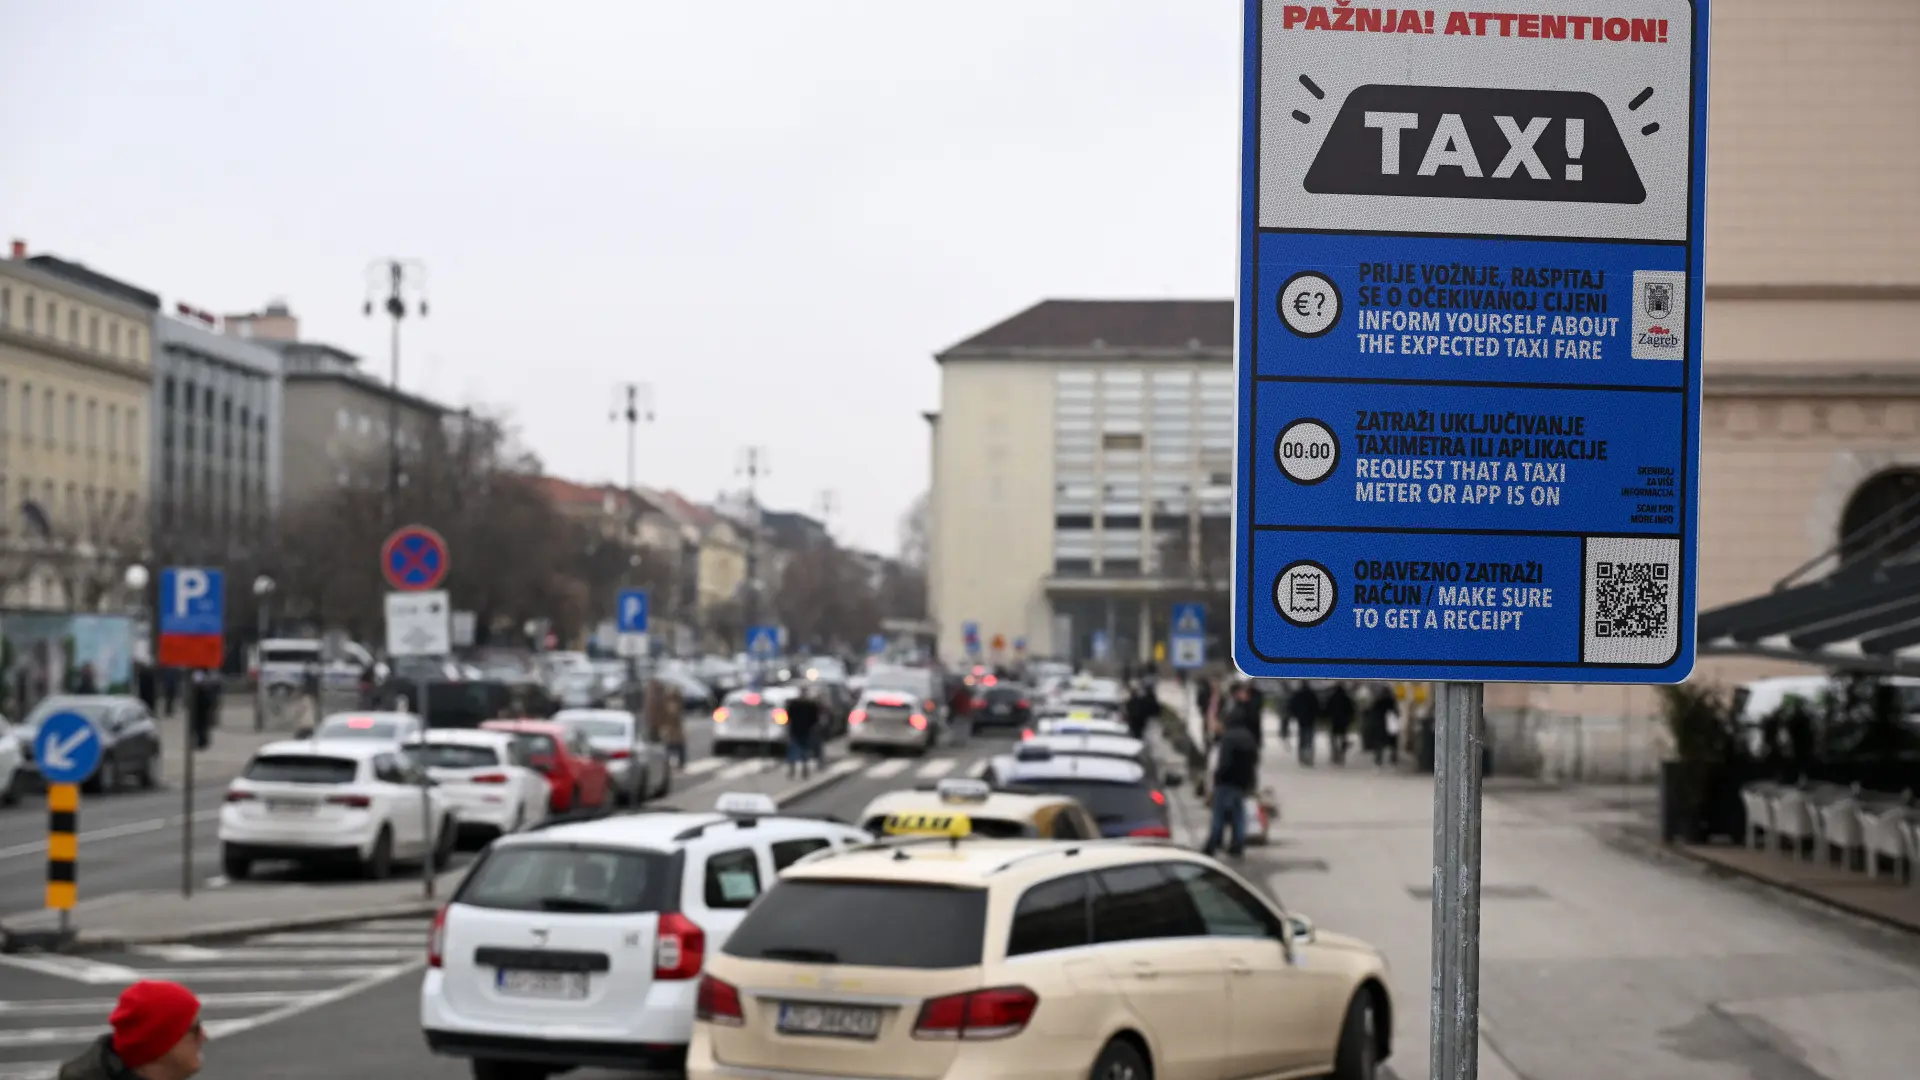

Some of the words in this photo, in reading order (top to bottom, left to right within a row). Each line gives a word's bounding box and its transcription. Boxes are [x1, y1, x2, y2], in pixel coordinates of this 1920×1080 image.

[1283, 0, 1434, 34] PAŽNJA!
[1444, 11, 1668, 43] ATTENTION!
[1364, 111, 1585, 181] TAX!
[1360, 262, 1416, 284] PRIJE
[1421, 263, 1504, 288] VOŽNJE,
[1512, 267, 1605, 290] RASPITAJ
[1293, 291, 1326, 317] €?
[1358, 286, 1381, 307] SE
[1388, 287, 1402, 307] O
[1408, 286, 1537, 311] OČEKIVANOJ
[1543, 292, 1607, 313] CIJENI
[1358, 310, 1440, 332] INFORM
[1446, 312, 1547, 335] YOURSELF
[1550, 316, 1620, 337] ABOUT
[1358, 333, 1395, 354] THE
[1401, 335, 1500, 357] EXPECTED
[1505, 337, 1549, 359] TAXI
[1555, 339, 1602, 360] FARE
[1638, 333, 1678, 348] Zagreb
[1356, 409, 1435, 432] ZATRAŽI
[1441, 411, 1585, 436] UKLJUČIVANJE
[1283, 442, 1330, 459] 00:00
[1355, 435, 1466, 457] TAXIMETRA
[1471, 437, 1494, 457] ILI
[1497, 438, 1608, 460] APLIKACIJE
[1356, 458, 1446, 480] REQUEST
[1450, 461, 1501, 481] THAT
[1504, 462, 1519, 481] A
[1521, 462, 1566, 483] TAXI
[1355, 482, 1422, 503] METER
[1427, 484, 1456, 504] OR
[1461, 485, 1501, 505] APP
[1507, 486, 1526, 505] IS
[1530, 486, 1561, 506] ON
[1630, 515, 1654, 524] MORE
[1636, 504, 1657, 513] SCAN
[1658, 505, 1674, 514] FOR
[1353, 560, 1461, 583] OBAVEZNO
[1465, 561, 1543, 584] ZATRAŽI
[174, 567, 210, 619] P
[1353, 582, 1422, 605] RAČUN
[1426, 585, 1435, 605] /
[1438, 586, 1497, 607] MAKE
[1502, 587, 1553, 608] SURE
[1353, 608, 1379, 629] TO
[1384, 609, 1421, 630] GET
[1424, 609, 1438, 630] A
[1443, 610, 1524, 631] RECEIPT
